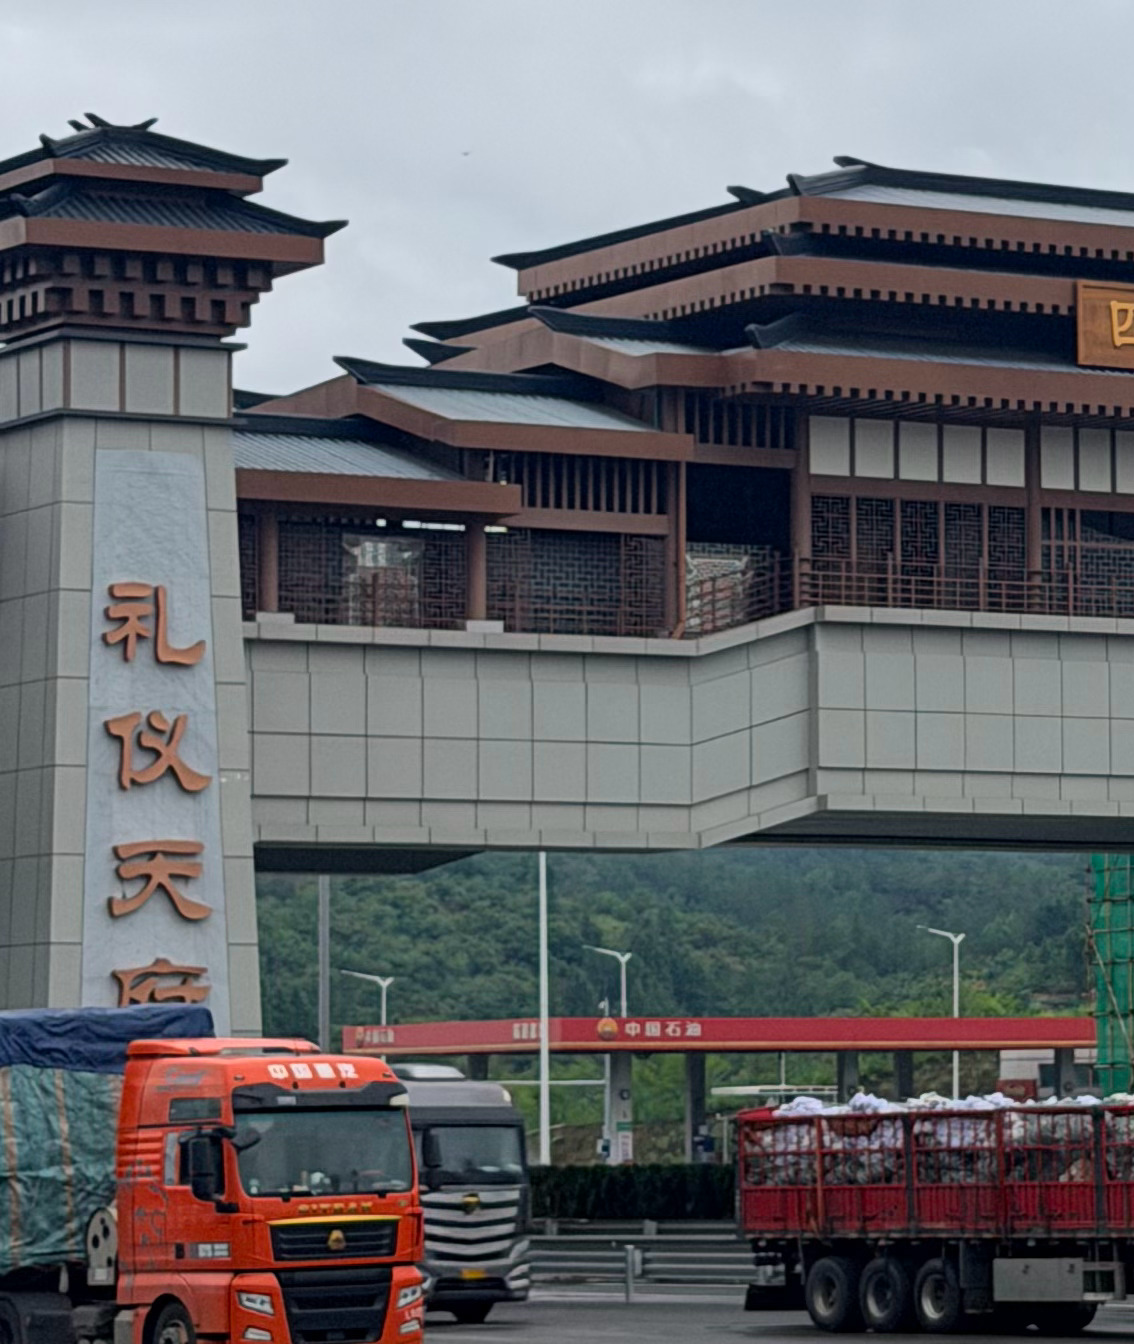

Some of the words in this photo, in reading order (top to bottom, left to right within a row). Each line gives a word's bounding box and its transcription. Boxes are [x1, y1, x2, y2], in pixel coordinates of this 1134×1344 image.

[103, 582, 213, 1006] 礼仪天府
[624, 1020, 702, 1038] 中国石油
